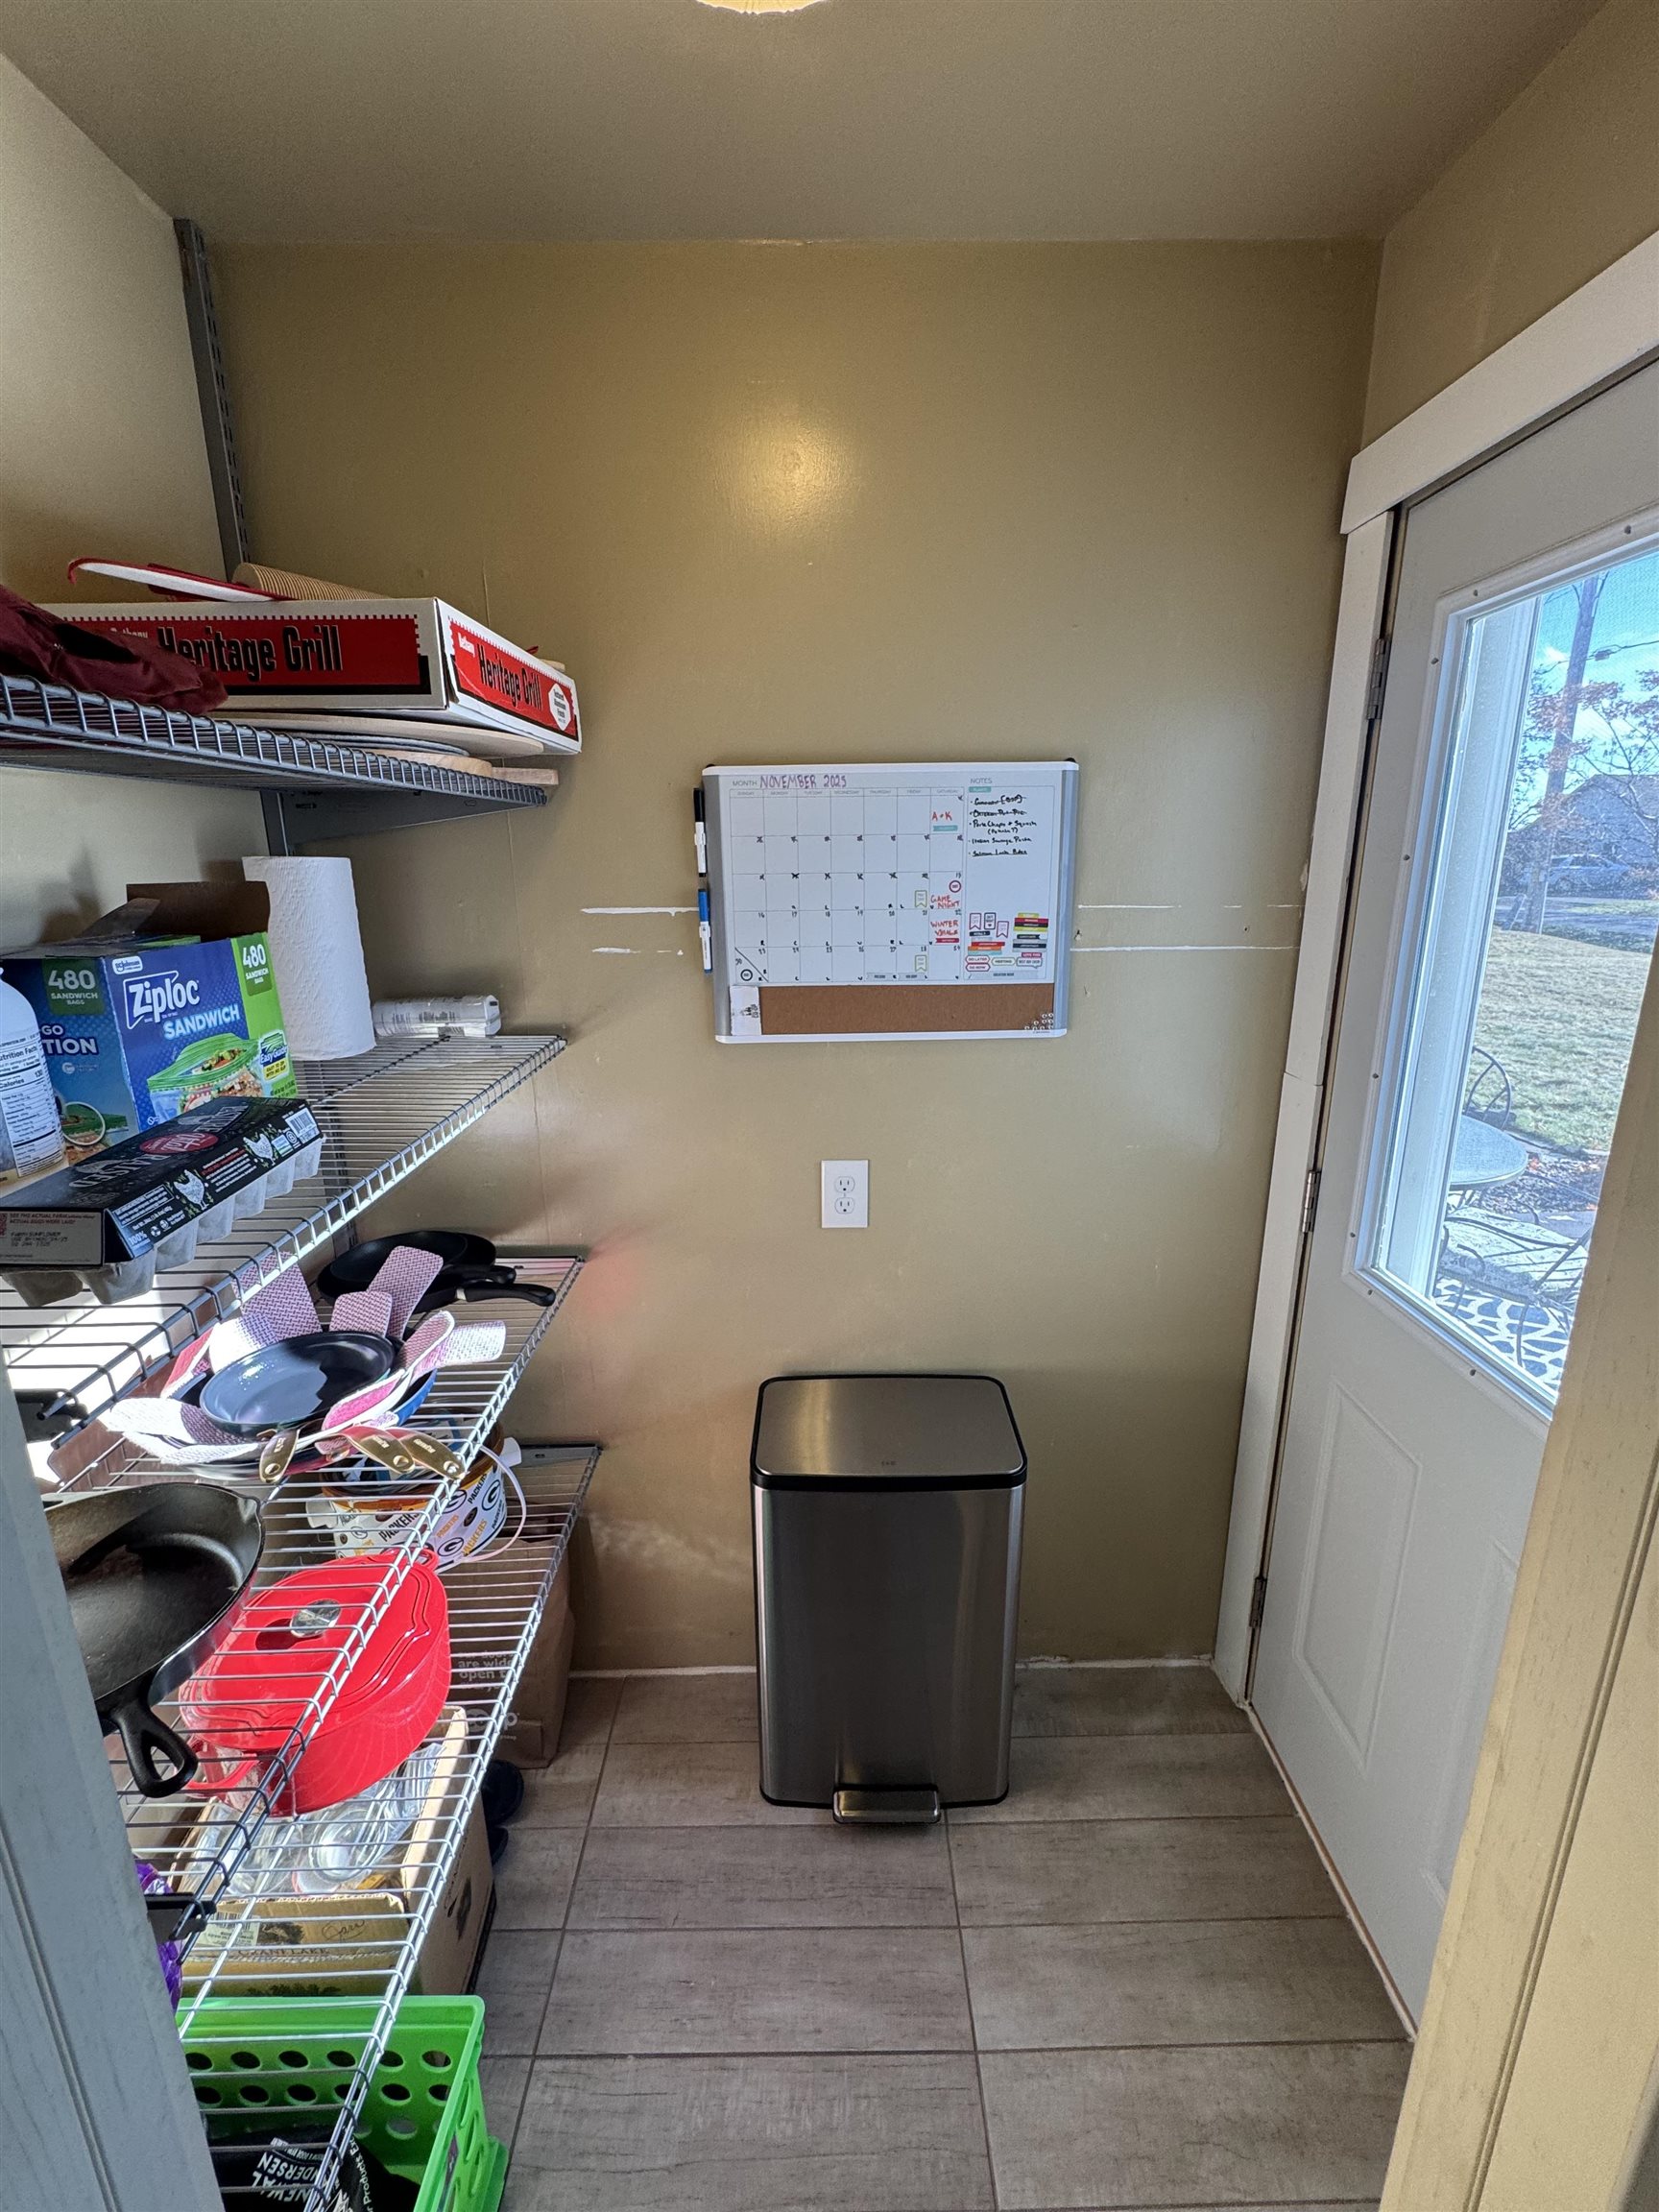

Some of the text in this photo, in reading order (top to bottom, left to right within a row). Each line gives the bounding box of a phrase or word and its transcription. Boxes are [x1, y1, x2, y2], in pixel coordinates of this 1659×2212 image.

[157, 625, 344, 682] Heritage Grill
[476, 643, 543, 710] Heritage Grill
[759, 774, 847, 789] NOVEMBER 2025
[930, 894, 952, 903] GAME
[937, 900, 960, 909] NIGHT
[243, 943, 267, 969] 480
[48, 969, 96, 990] 480
[128, 975, 201, 1023] Ziploc
[162, 1002, 240, 1040] SANDWICH
[68, 1153, 172, 1189] RAISED
[468, 1473, 488, 1504] PACKERS
[459, 1670, 495, 1682] open
[356, 2153, 373, 2205] Products
